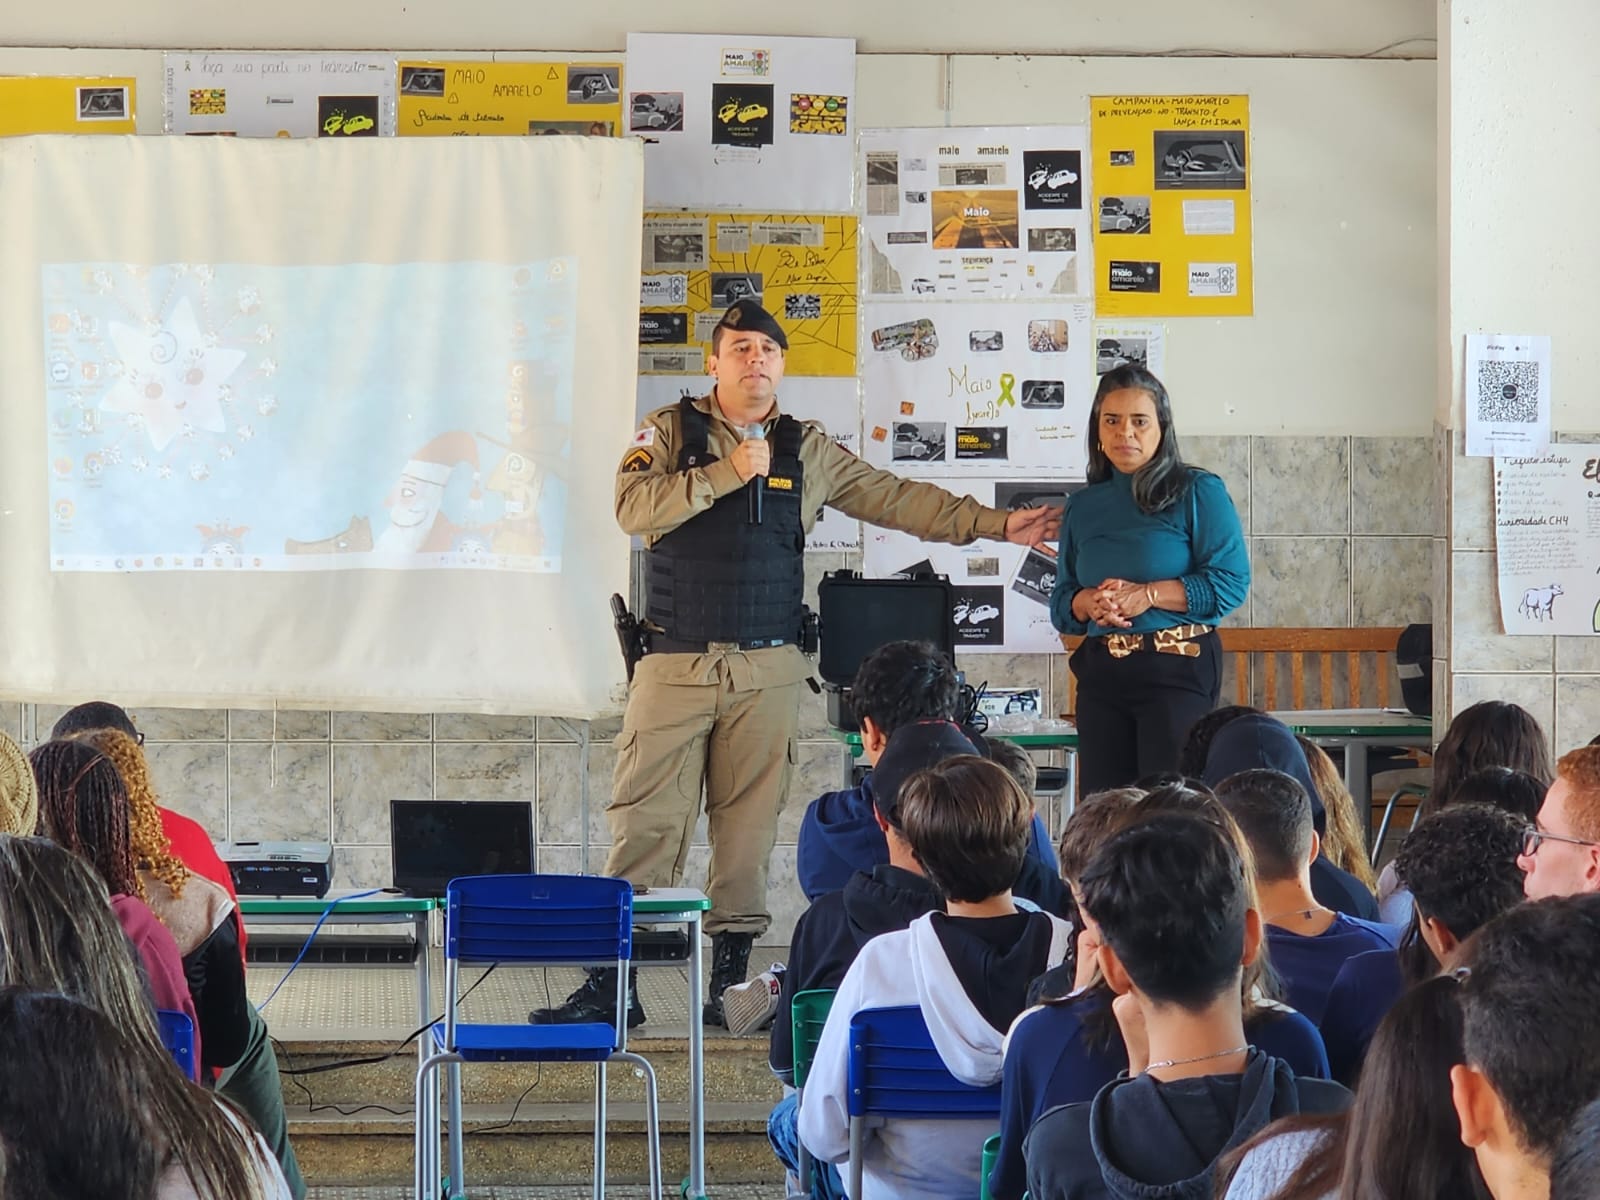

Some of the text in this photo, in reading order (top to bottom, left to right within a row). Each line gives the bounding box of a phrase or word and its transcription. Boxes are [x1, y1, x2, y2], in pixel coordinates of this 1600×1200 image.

[453, 69, 485, 85] MAIO
[493, 84, 543, 97] AMARELO
[1112, 96, 1165, 105] CAMPANHA
[938, 145, 960, 155] maio
[977, 144, 1009, 155] amarelo
[963, 207, 990, 217] Maio
[1111, 268, 1133, 277] maio
[1111, 275, 1145, 283] amarelo
[947, 364, 993, 398] Maio
[957, 434, 980, 443] maio
[957, 441, 992, 449] amarelo
[1548, 515, 1570, 526] CH4
